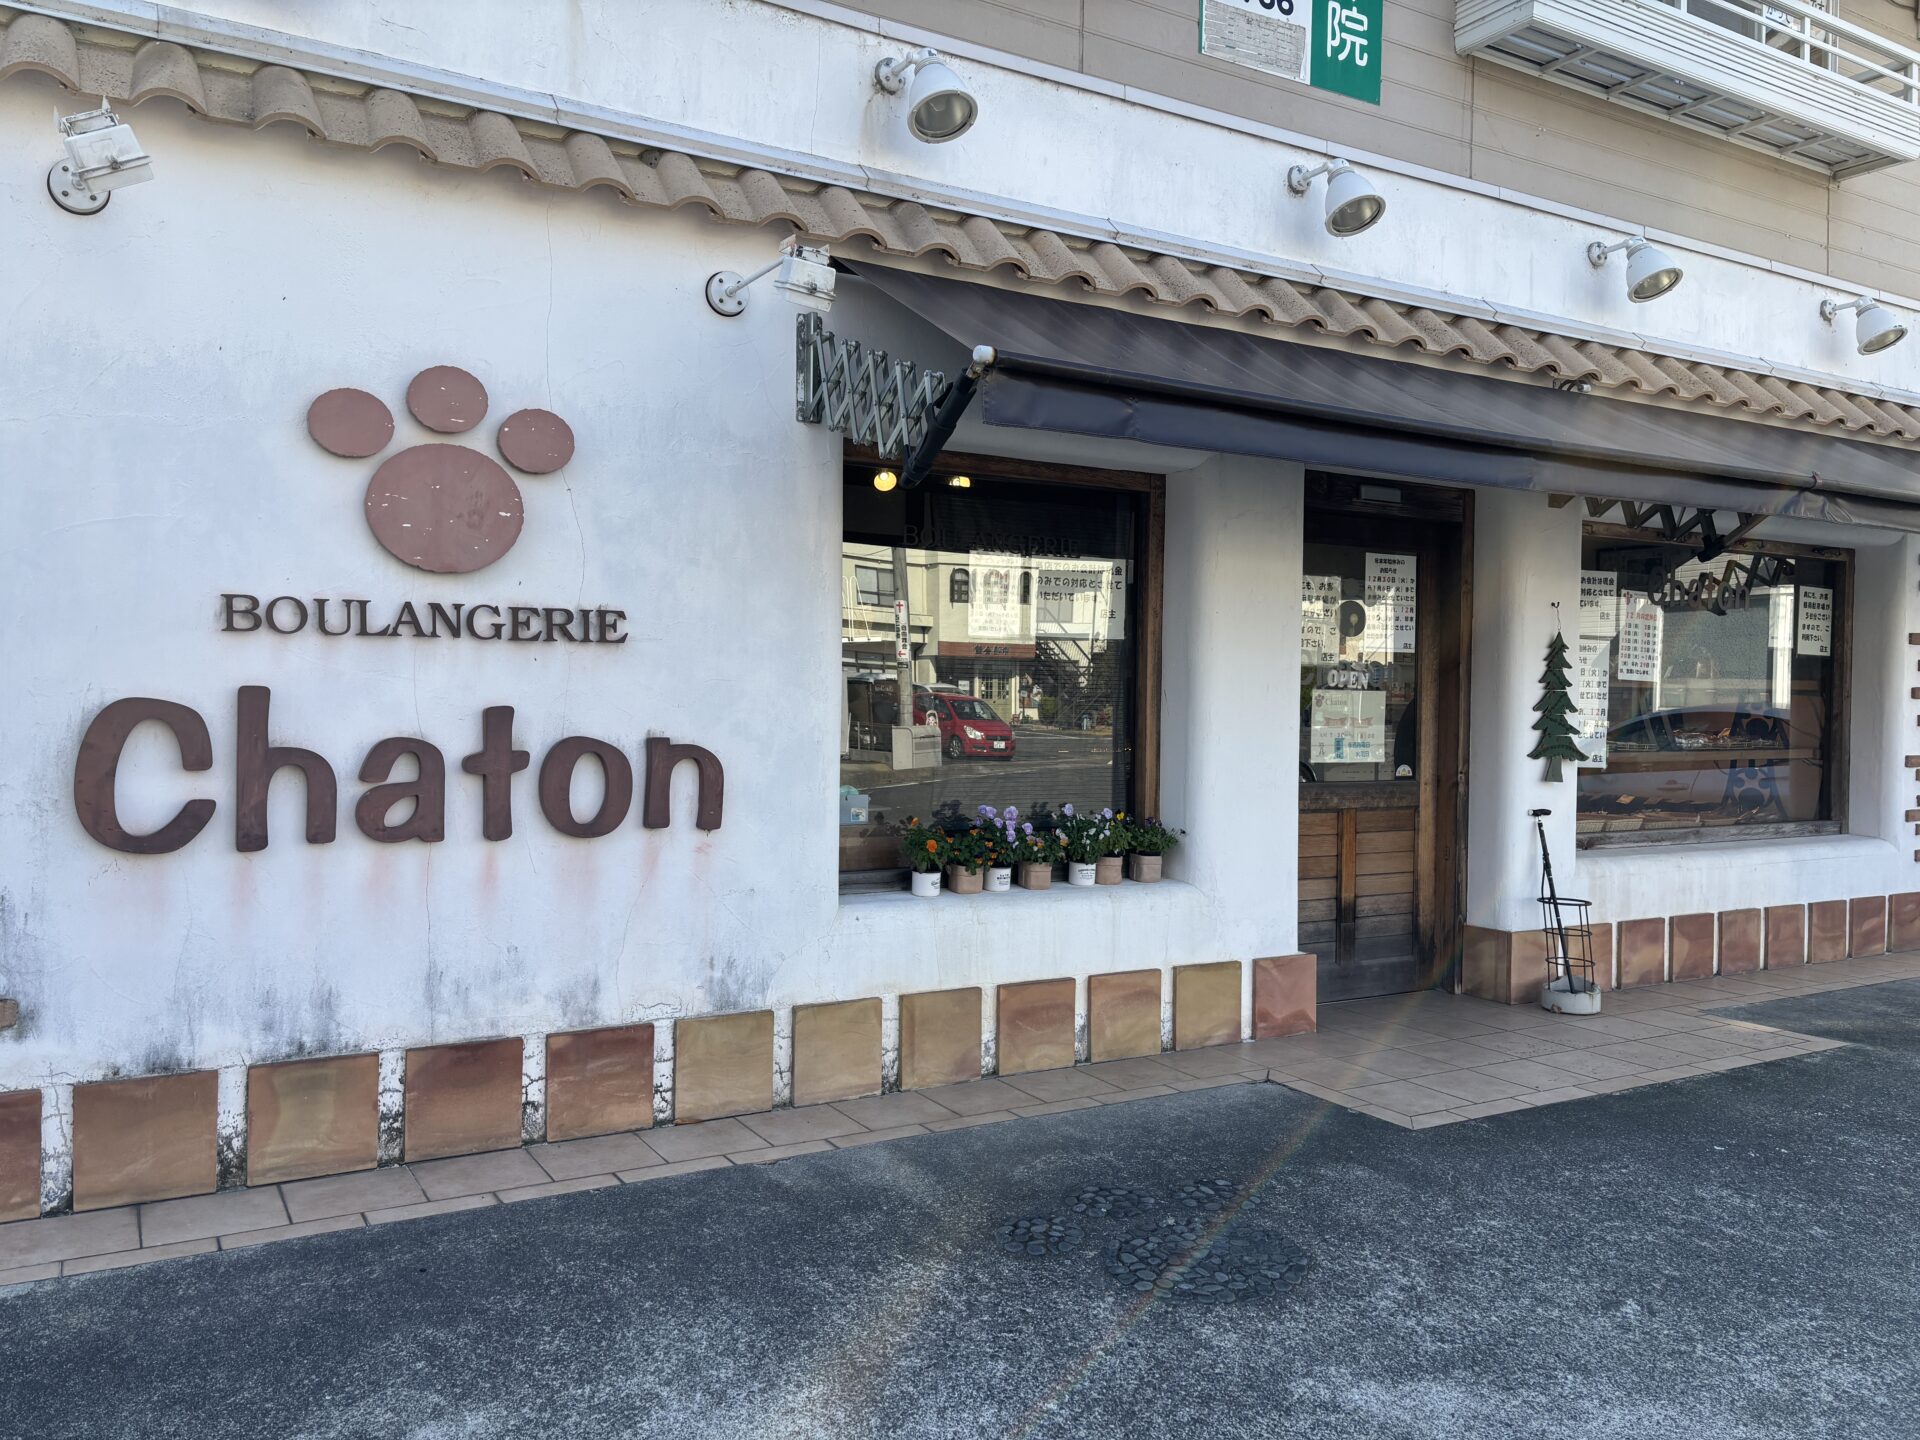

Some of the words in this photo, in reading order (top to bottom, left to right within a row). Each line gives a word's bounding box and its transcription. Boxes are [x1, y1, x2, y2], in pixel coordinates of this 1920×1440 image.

[1326, 0, 1369, 67] 院
[903, 524, 1081, 559] BOUANGERIE
[220, 593, 629, 644] BOULANGERIE
[1327, 669, 1369, 690] OPEN
[73, 685, 724, 854] Chaton
